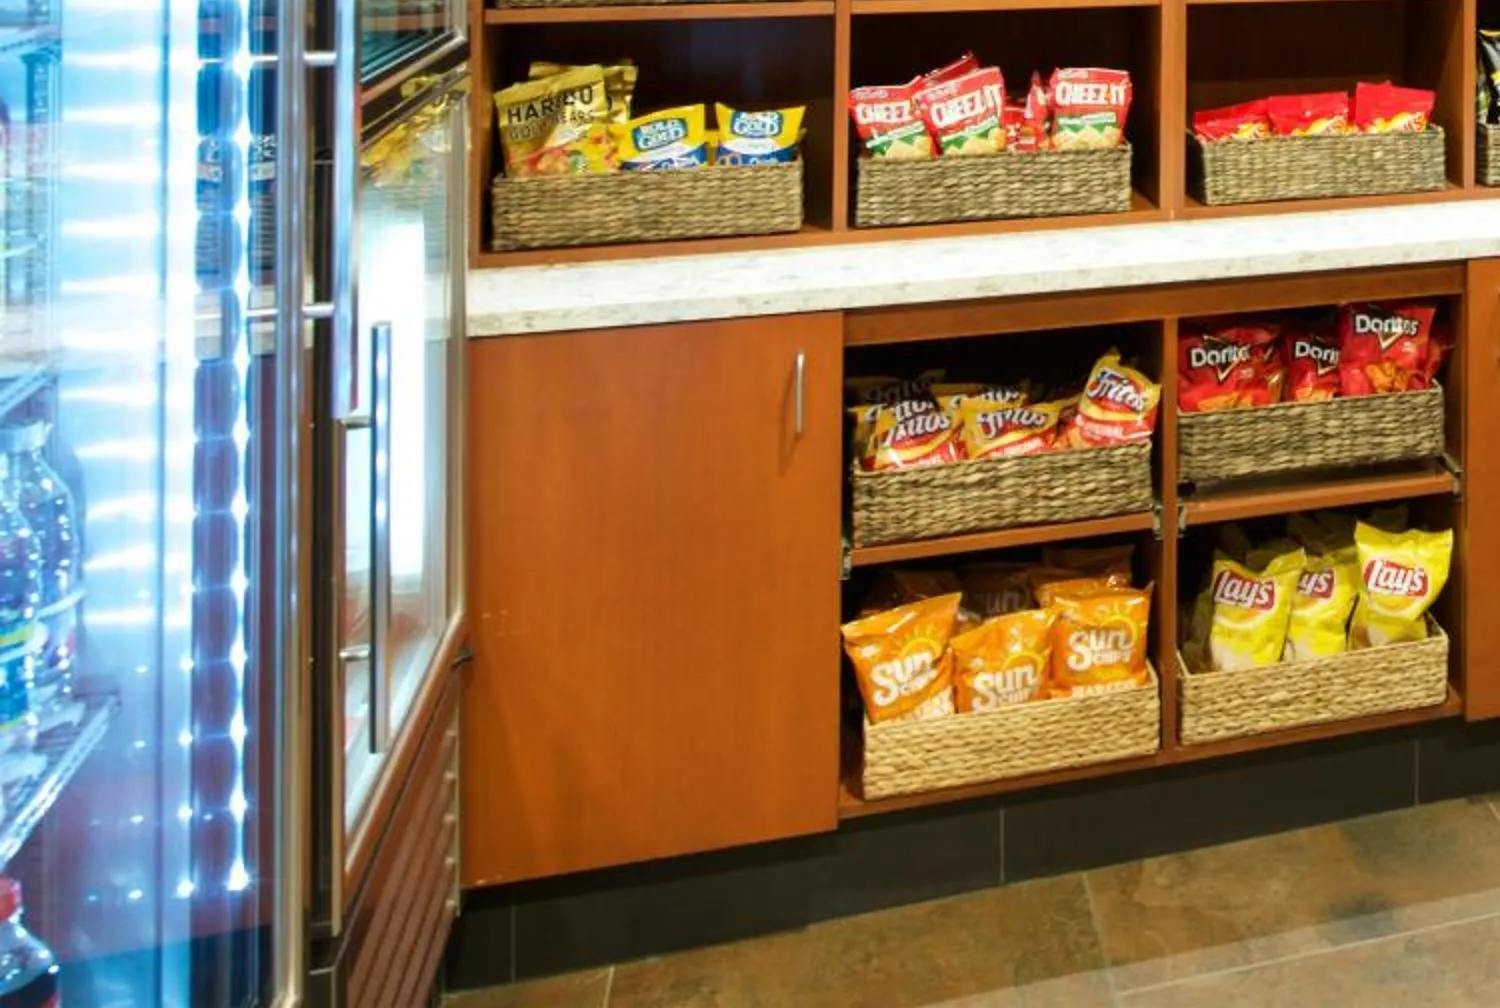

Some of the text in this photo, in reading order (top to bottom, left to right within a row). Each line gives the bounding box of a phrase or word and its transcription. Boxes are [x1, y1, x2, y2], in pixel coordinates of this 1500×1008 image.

[1355, 315, 1419, 336] Doritos
[1088, 366, 1150, 412] Fritos
[1068, 631, 1132, 671] Sun
[871, 651, 934, 707] Sun
[972, 664, 1036, 713] Sun
